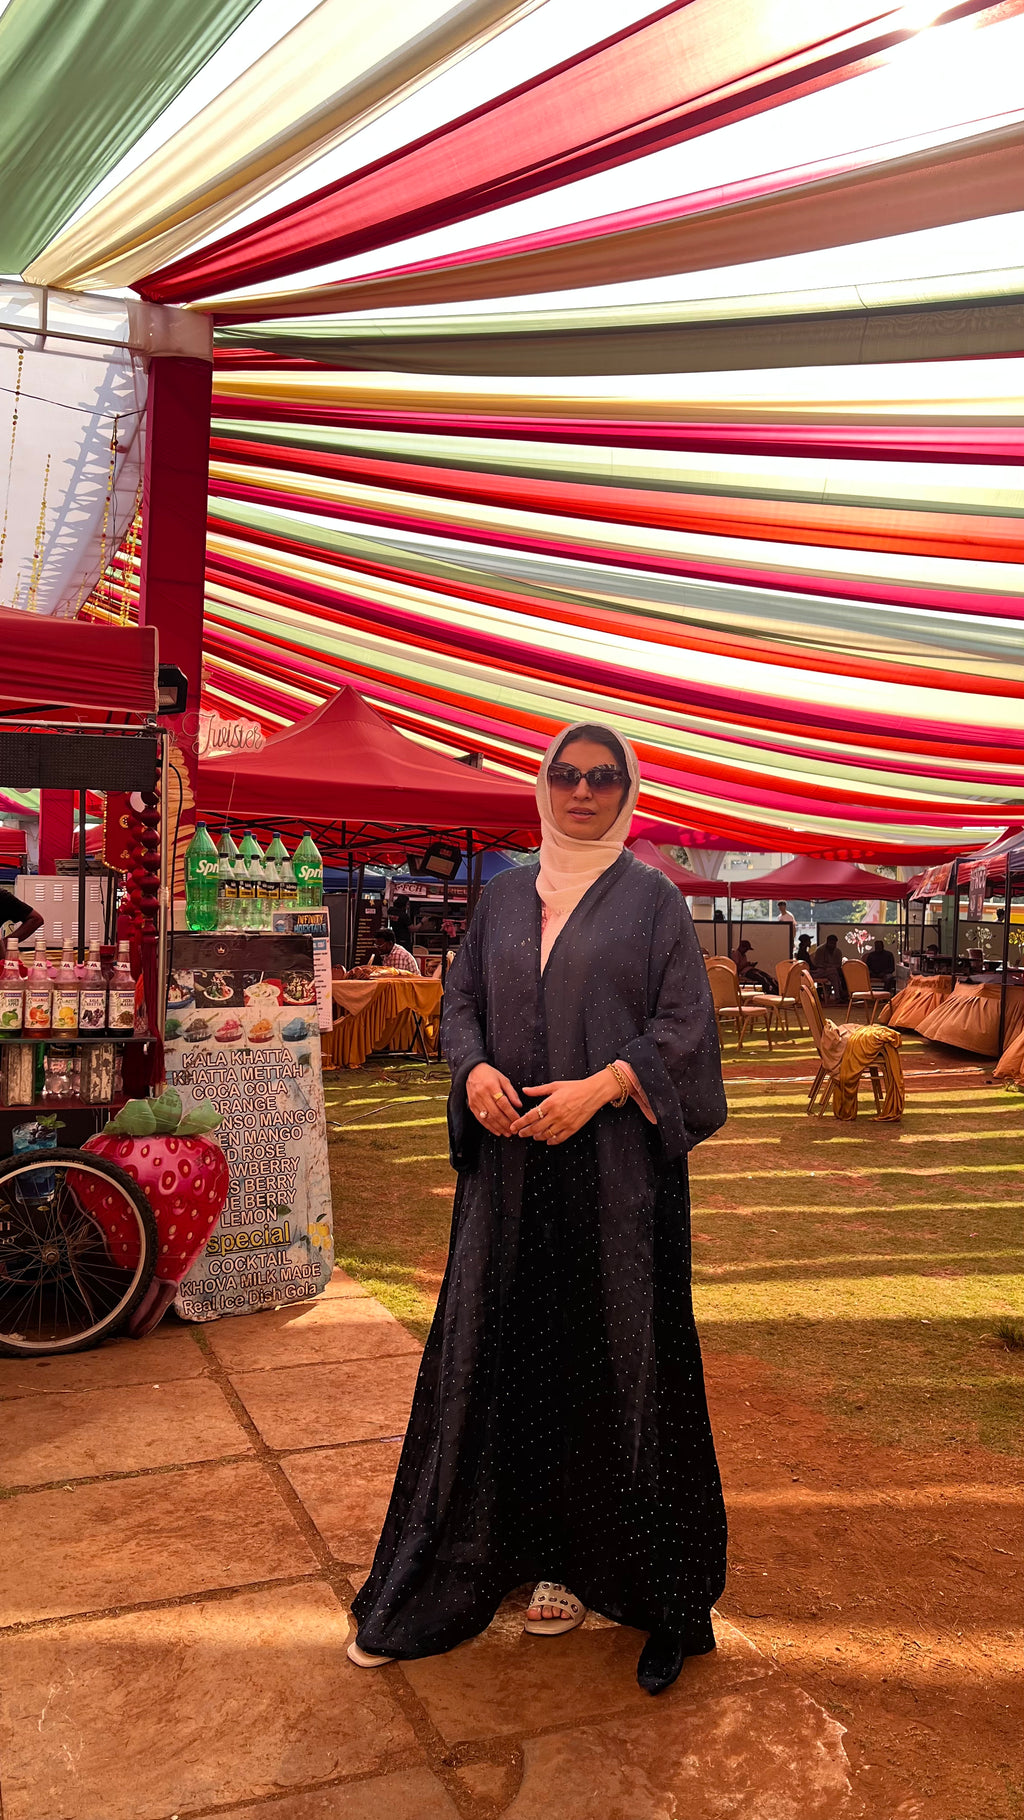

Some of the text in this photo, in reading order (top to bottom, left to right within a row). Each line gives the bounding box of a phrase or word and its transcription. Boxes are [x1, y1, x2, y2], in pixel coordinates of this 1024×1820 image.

[182, 712, 263, 755] Twister
[182, 1048, 292, 1068] KALA KHATTA
[172, 1064, 303, 1086] KHATTA METTAH
[192, 1080, 288, 1100] COCA COLA
[259, 1109, 317, 1127] MANGO
[244, 1126, 302, 1144] MANGO
[242, 1143, 286, 1160] ROSE
[244, 1173, 297, 1193] BERRY
[244, 1189, 297, 1209] BERRY
[220, 1207, 278, 1228] LEMON
[206, 1220, 290, 1256] special
[209, 1250, 292, 1275] COCKTAIL
[180, 1262, 321, 1297] KHOVA MILK MADE
[183, 1282, 317, 1315] Real Ice Dish Gola
